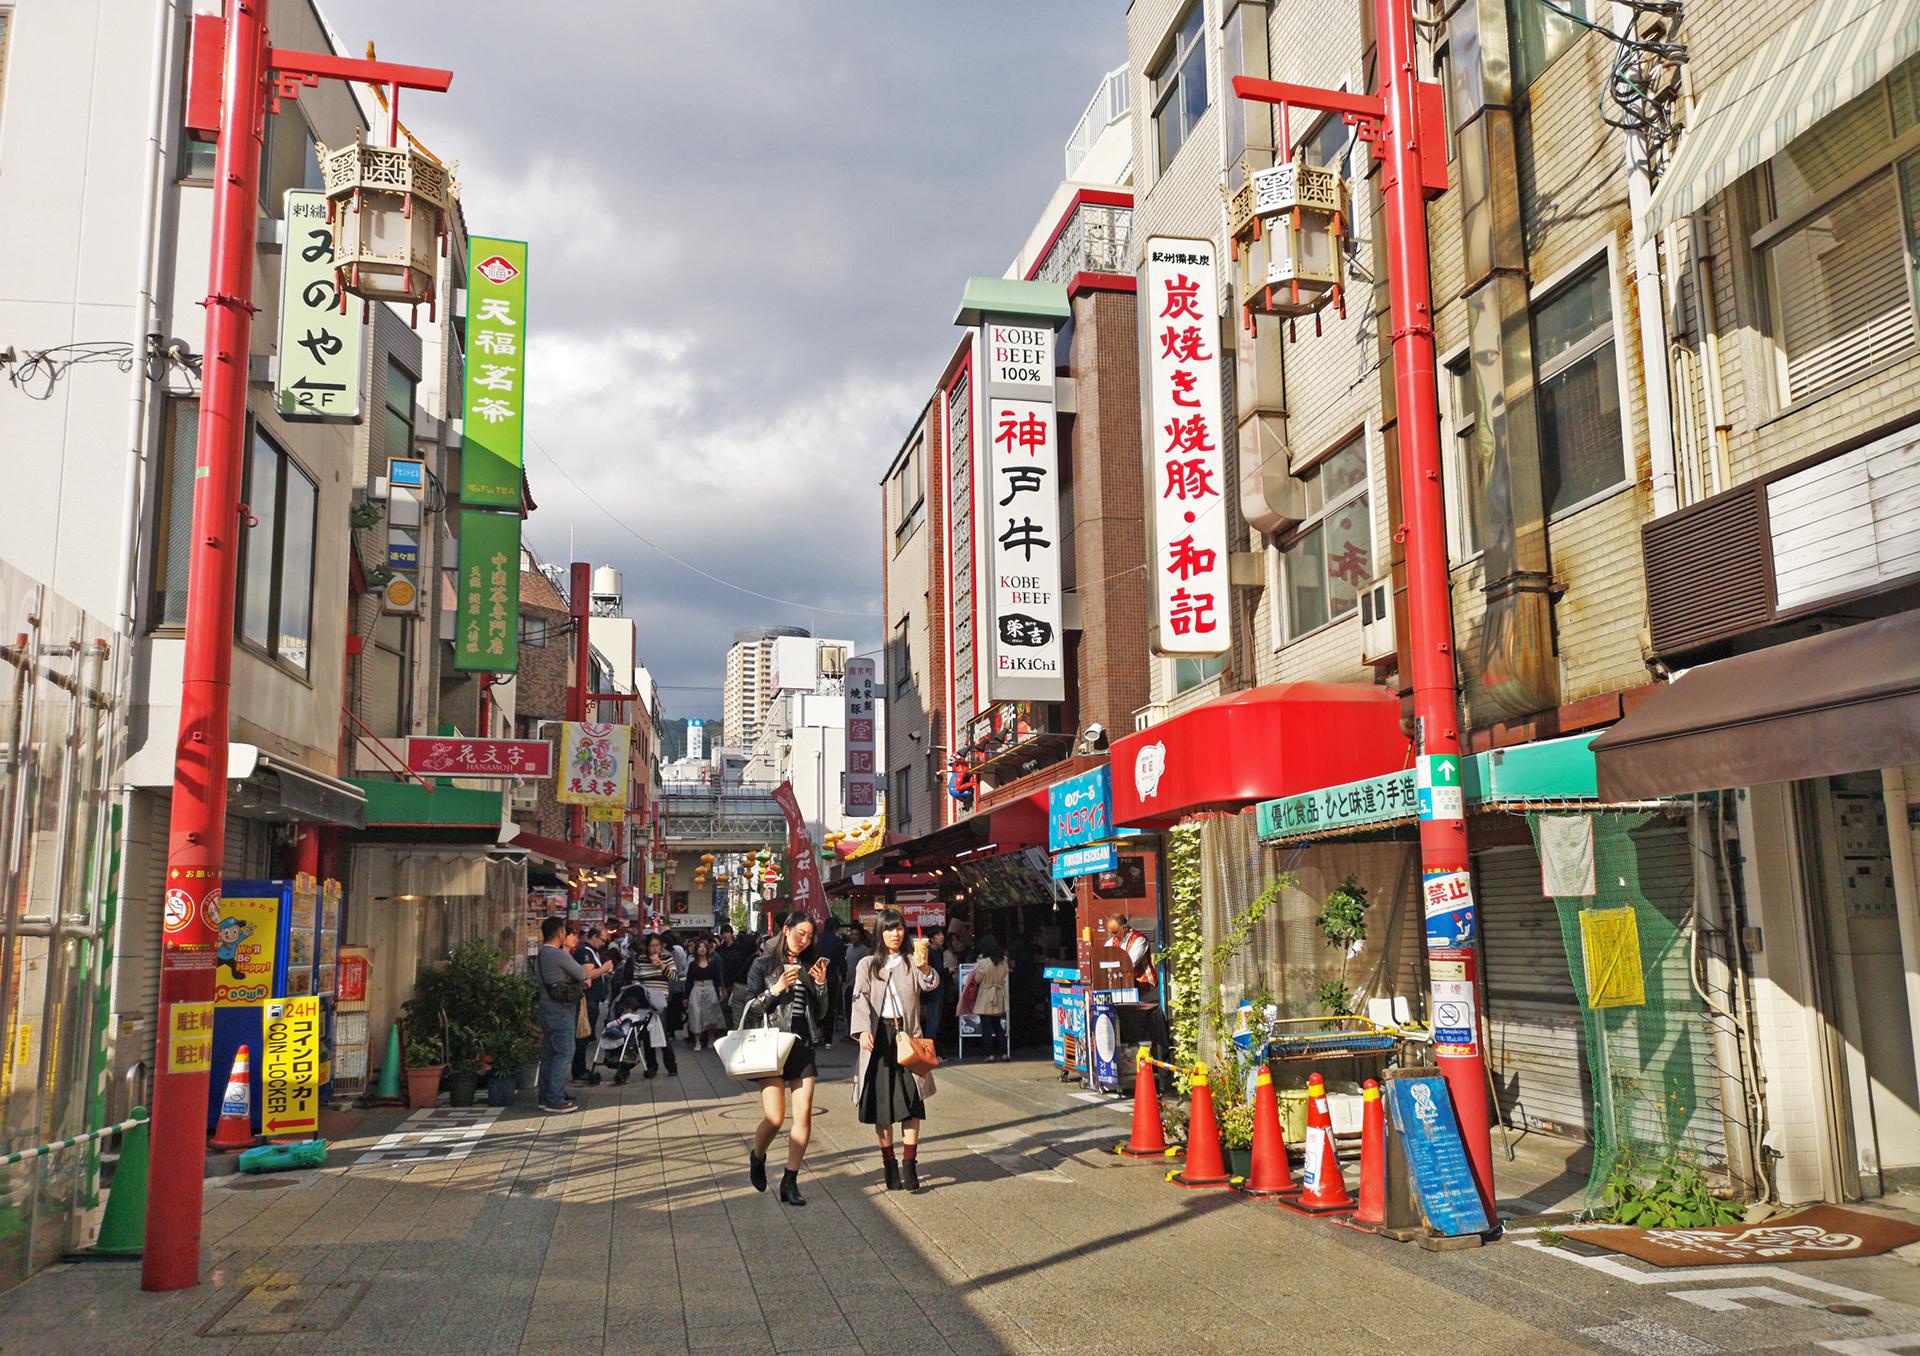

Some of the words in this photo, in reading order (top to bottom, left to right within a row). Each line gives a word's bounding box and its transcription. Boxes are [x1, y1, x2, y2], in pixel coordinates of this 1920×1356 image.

[1152, 251, 1210, 266] 紀州備長炭
[297, 229, 343, 366] みのや
[995, 328, 1045, 346] KOBE
[472, 298, 516, 424] 天福茗茶
[997, 347, 1045, 364] BEEF
[1002, 367, 1041, 381] 100%
[298, 392, 335, 407] 2F
[995, 410, 1051, 562] 神戸牛
[1000, 576, 1040, 589] KOBE
[1012, 592, 1051, 604] BEEF
[999, 655, 1056, 670] EiKiChi
[456, 744, 524, 765] 花文字
[466, 763, 514, 772] HANAMOJI
[568, 779, 617, 797] 花文字
[1059, 802, 1106, 840] トルコアイス
[1428, 878, 1468, 906] 禁止
[237, 945, 261, 953] We'll
[237, 954, 251, 962] Be
[237, 962, 271, 973] Happy!
[286, 1003, 317, 1018] 24H
[268, 1022, 288, 1114] COIN-LOCKER
[292, 1021, 313, 1111] コインロッカー
